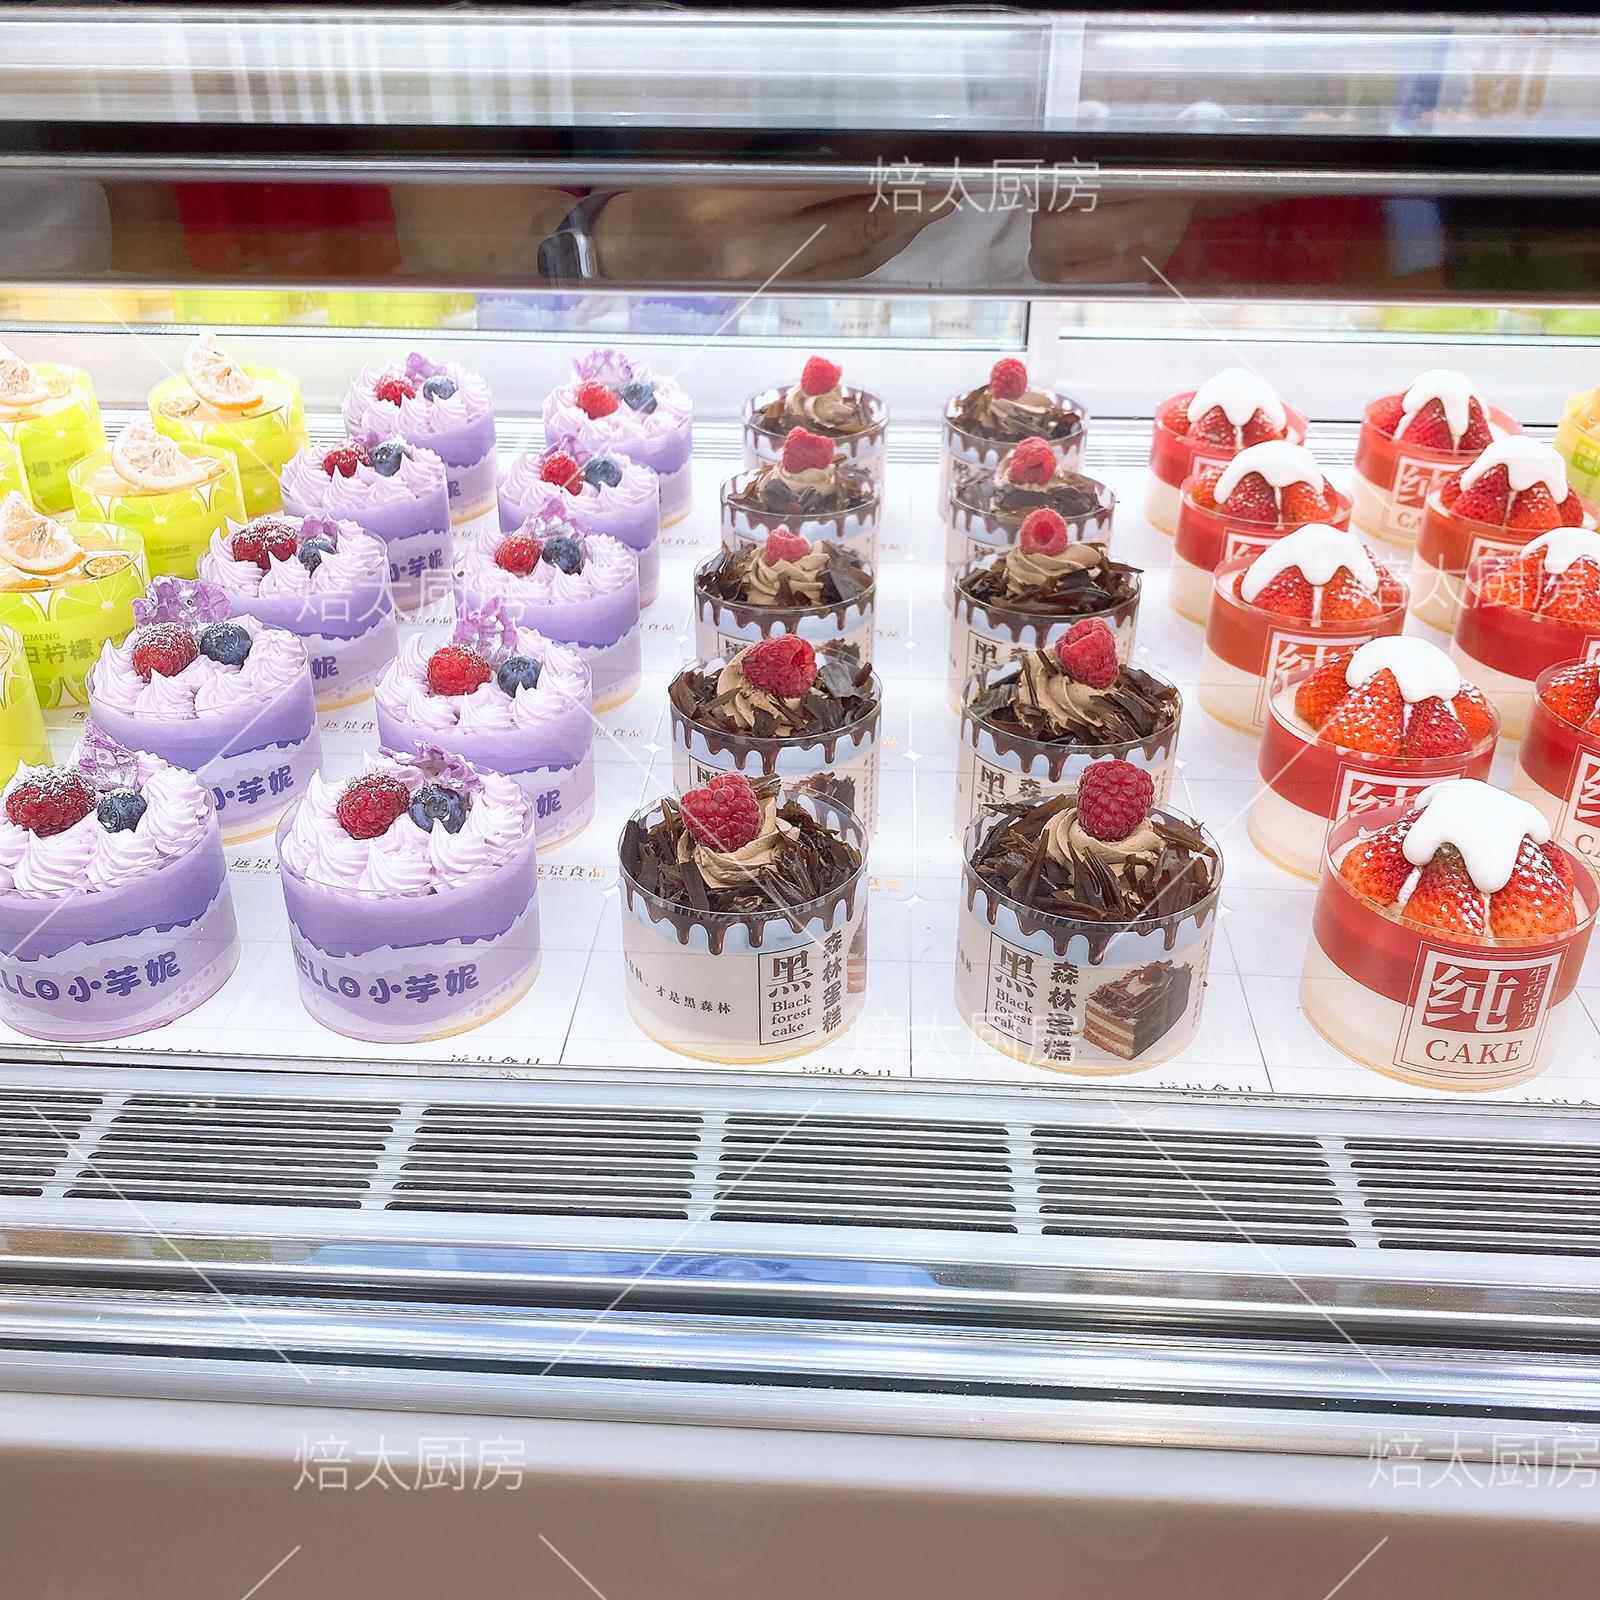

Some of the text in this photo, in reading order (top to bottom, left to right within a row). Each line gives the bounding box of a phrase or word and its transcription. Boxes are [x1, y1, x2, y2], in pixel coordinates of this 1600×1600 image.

[0, 969, 60, 1001] LLO
[767, 950, 814, 998] 黑
[822, 931, 843, 1034] 森林蛋糕
[993, 944, 1038, 998] 黑
[771, 994, 812, 1013] Black
[996, 988, 1033, 1014] Black
[1043, 961, 1079, 1062] 森林蛋糕
[1424, 966, 1520, 1032] 纯
[1517, 967, 1548, 1029] 生巧克力
[771, 1007, 813, 1026] forest
[994, 1014, 1024, 1035] cake
[995, 1001, 1033, 1026] forest
[771, 1022, 805, 1038] cake
[1425, 1039, 1524, 1065] CAKE
